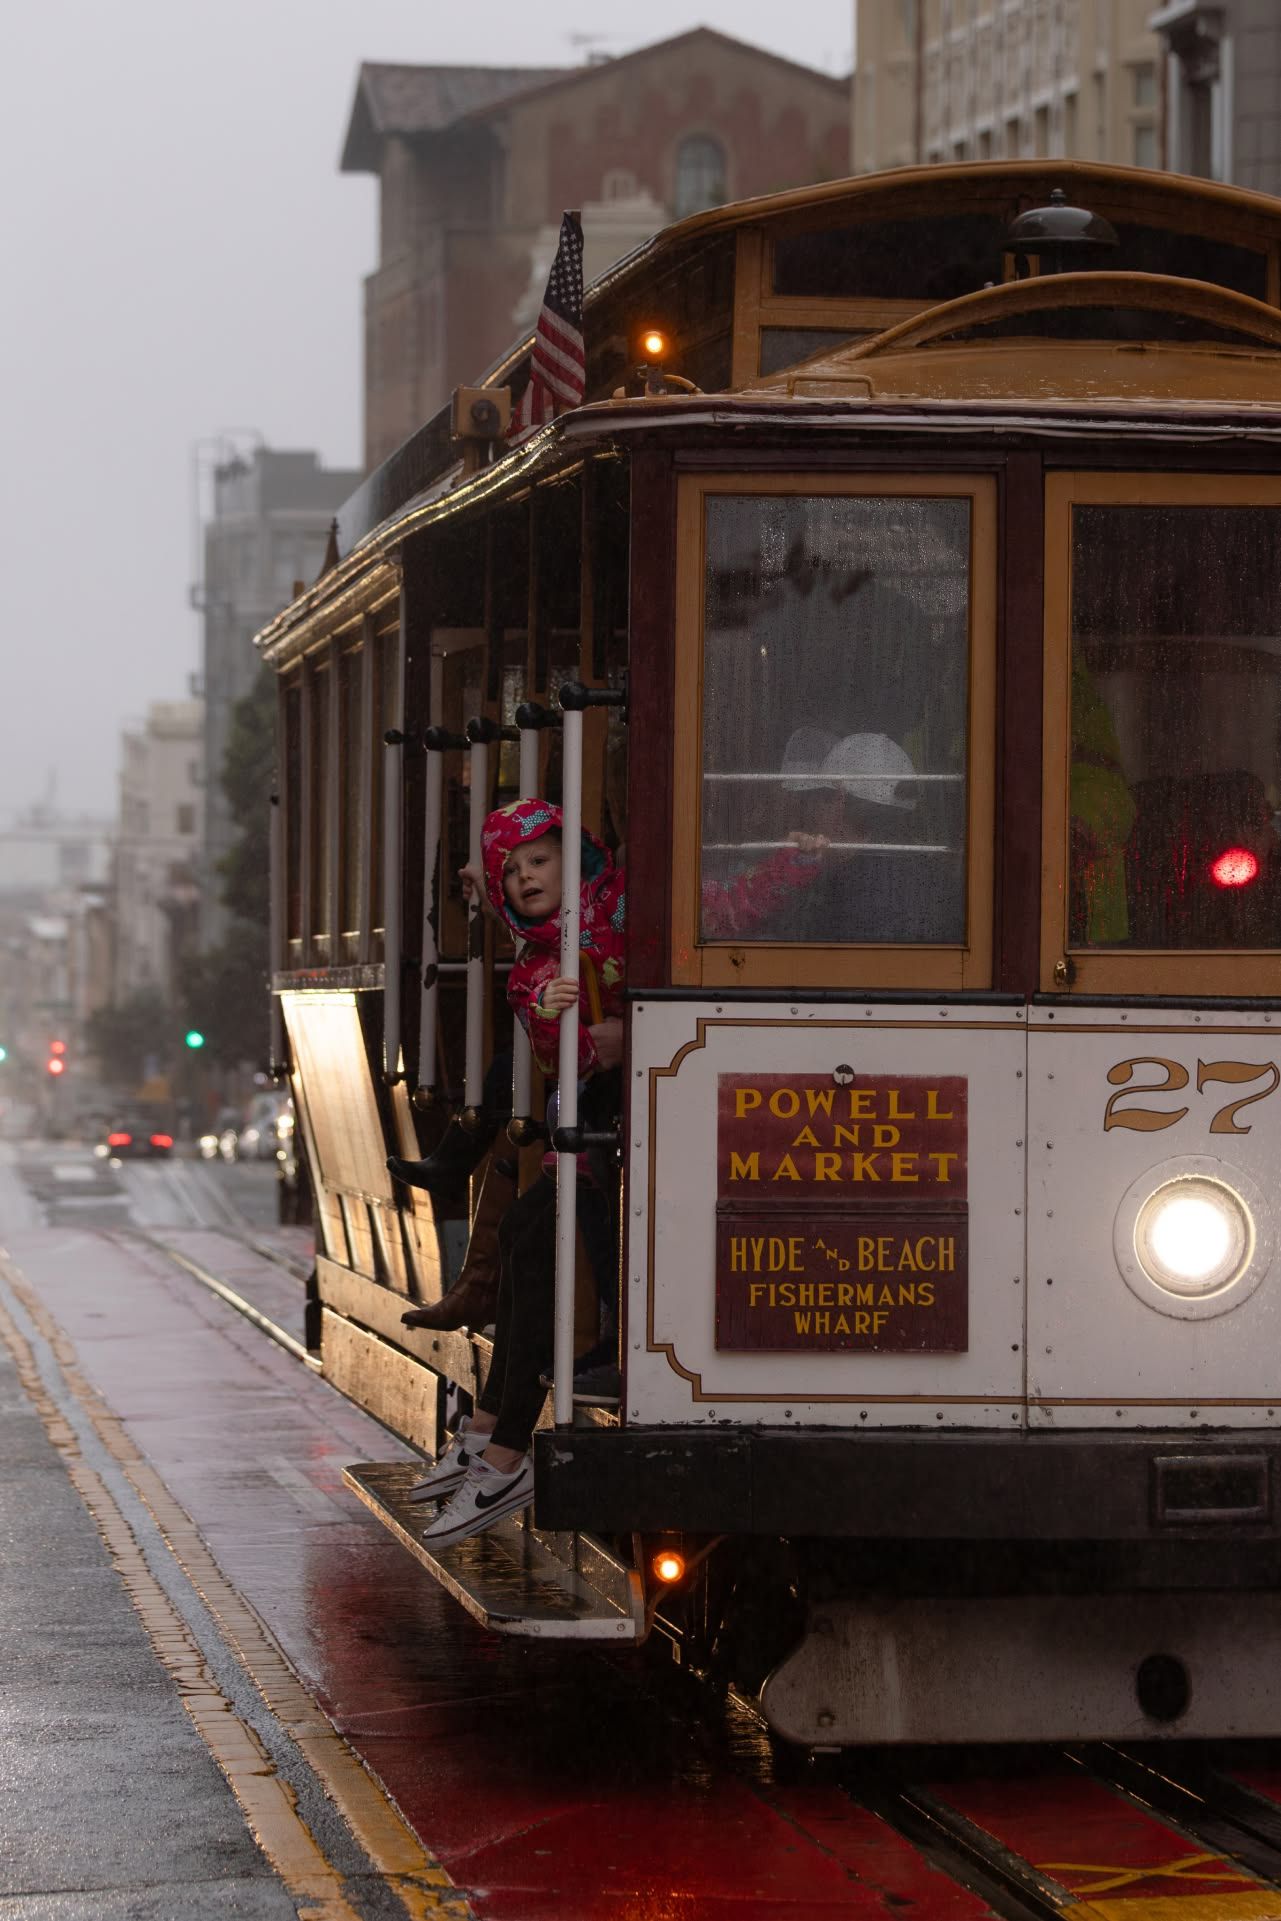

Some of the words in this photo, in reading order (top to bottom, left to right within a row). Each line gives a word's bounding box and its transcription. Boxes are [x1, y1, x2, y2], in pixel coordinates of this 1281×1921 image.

[735, 1088, 953, 1119] POWELL
[1104, 1057, 1280, 1134] 27
[792, 1124, 901, 1147] AND
[729, 1152, 957, 1182] MARKET
[730, 1237, 805, 1271] HYDE
[815, 1238, 850, 1271] AND
[858, 1236, 955, 1271] BEACH
[749, 1283, 935, 1306] FISHERMANS
[794, 1311, 889, 1335] WHARF
